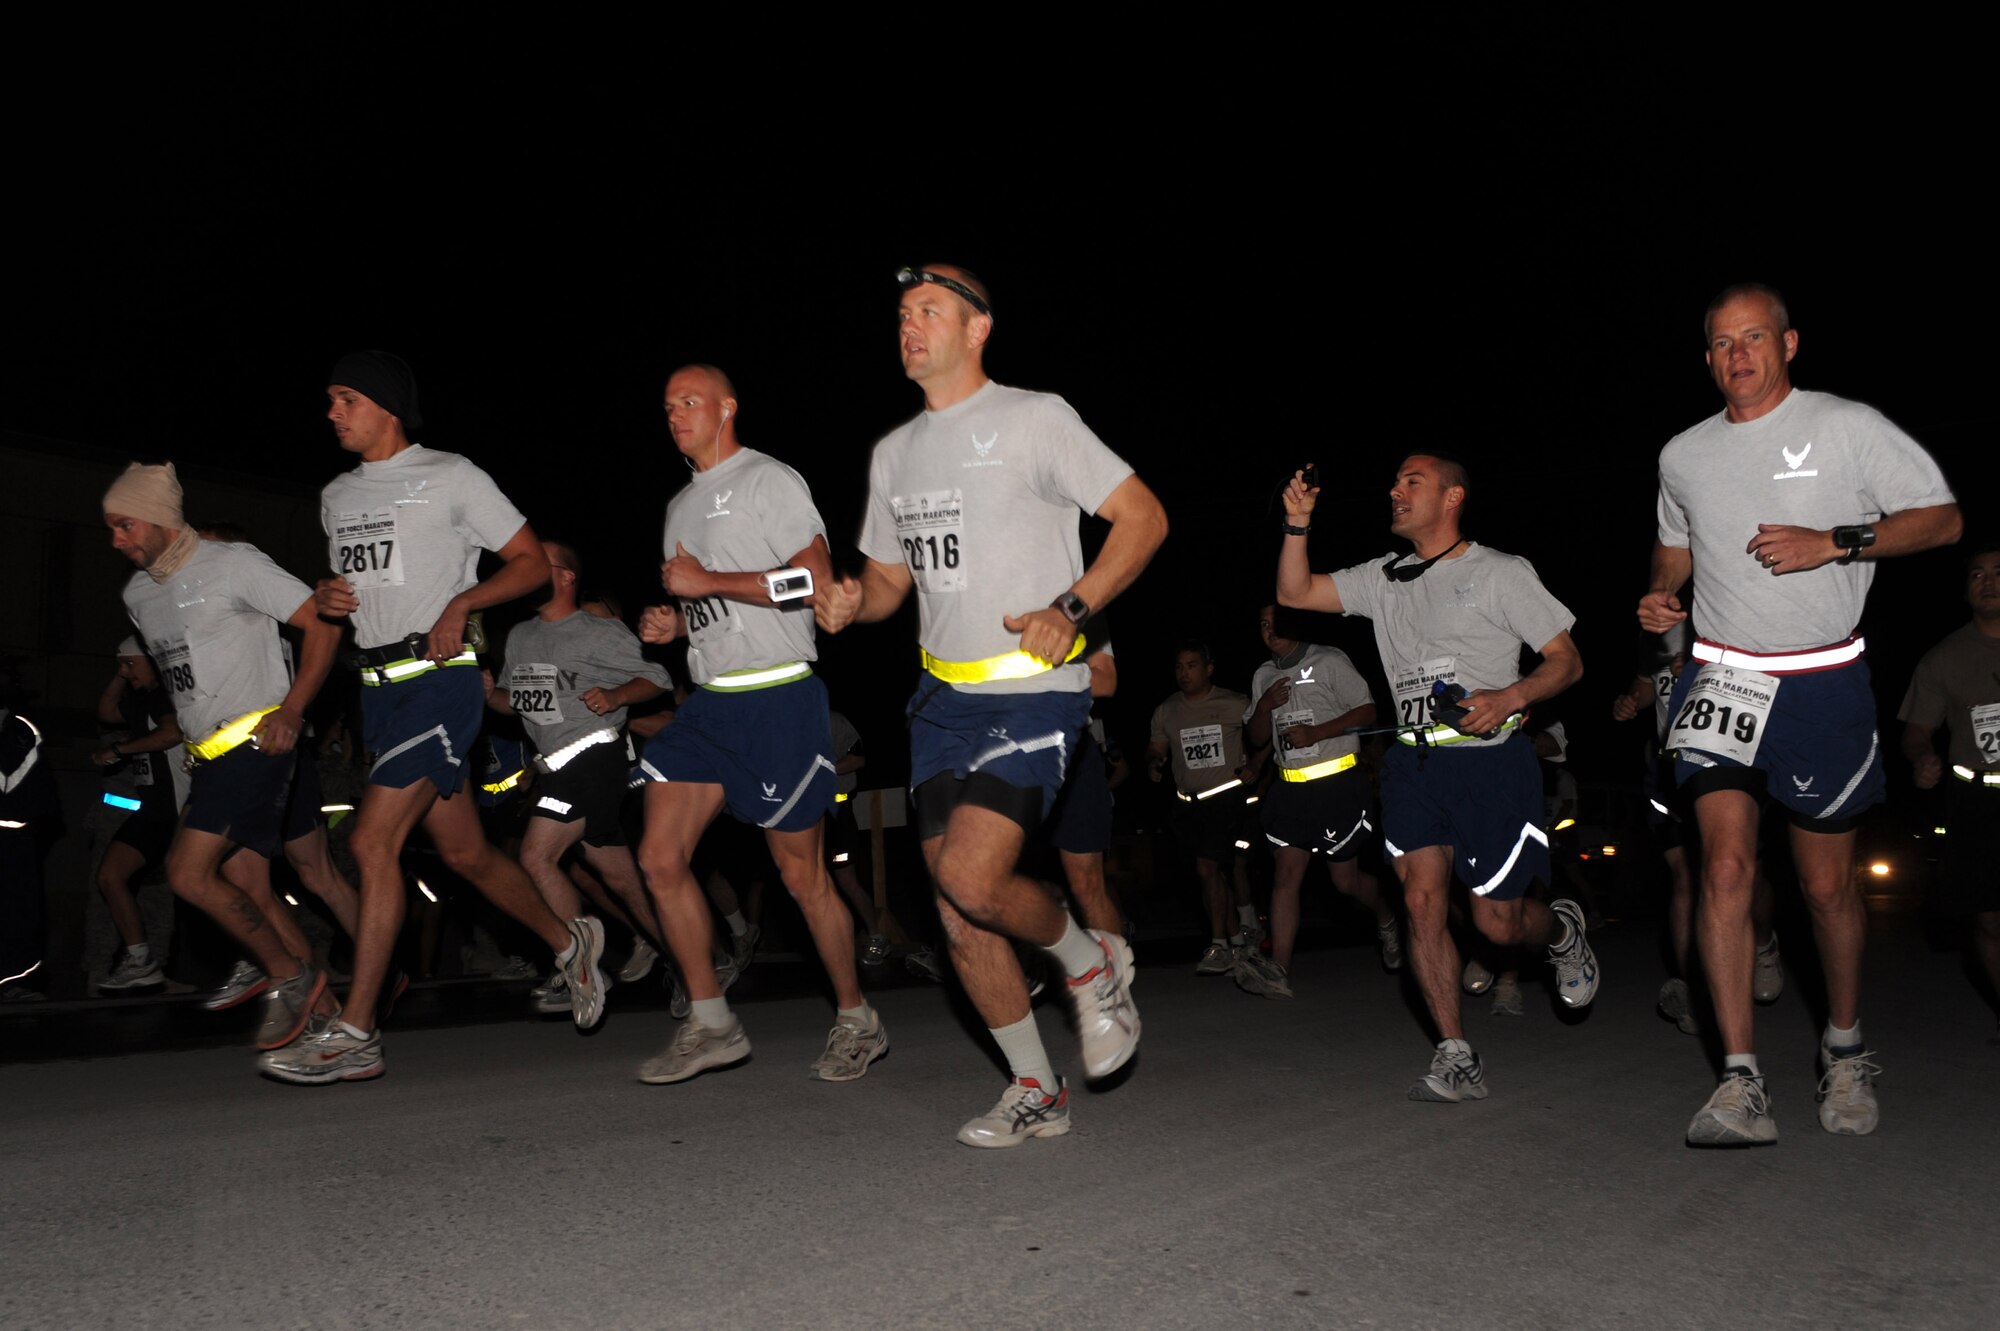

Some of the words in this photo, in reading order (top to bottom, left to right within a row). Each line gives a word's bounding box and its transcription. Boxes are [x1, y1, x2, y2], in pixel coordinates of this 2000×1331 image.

[922, 508, 960, 520] MARATHON
[346, 523, 363, 533] FORCE
[364, 520, 395, 531] MARATHON
[340, 540, 394, 575] 2817
[903, 533, 959, 571] 2816
[1404, 677, 1420, 687] FORCE
[1420, 671, 1456, 684] MARATHON
[512, 689, 556, 713] 2822
[1721, 681, 1772, 702] MARATHON
[1401, 694, 1440, 726] 279
[1674, 698, 1758, 744] 2819
[1185, 743, 1219, 761] 2821
